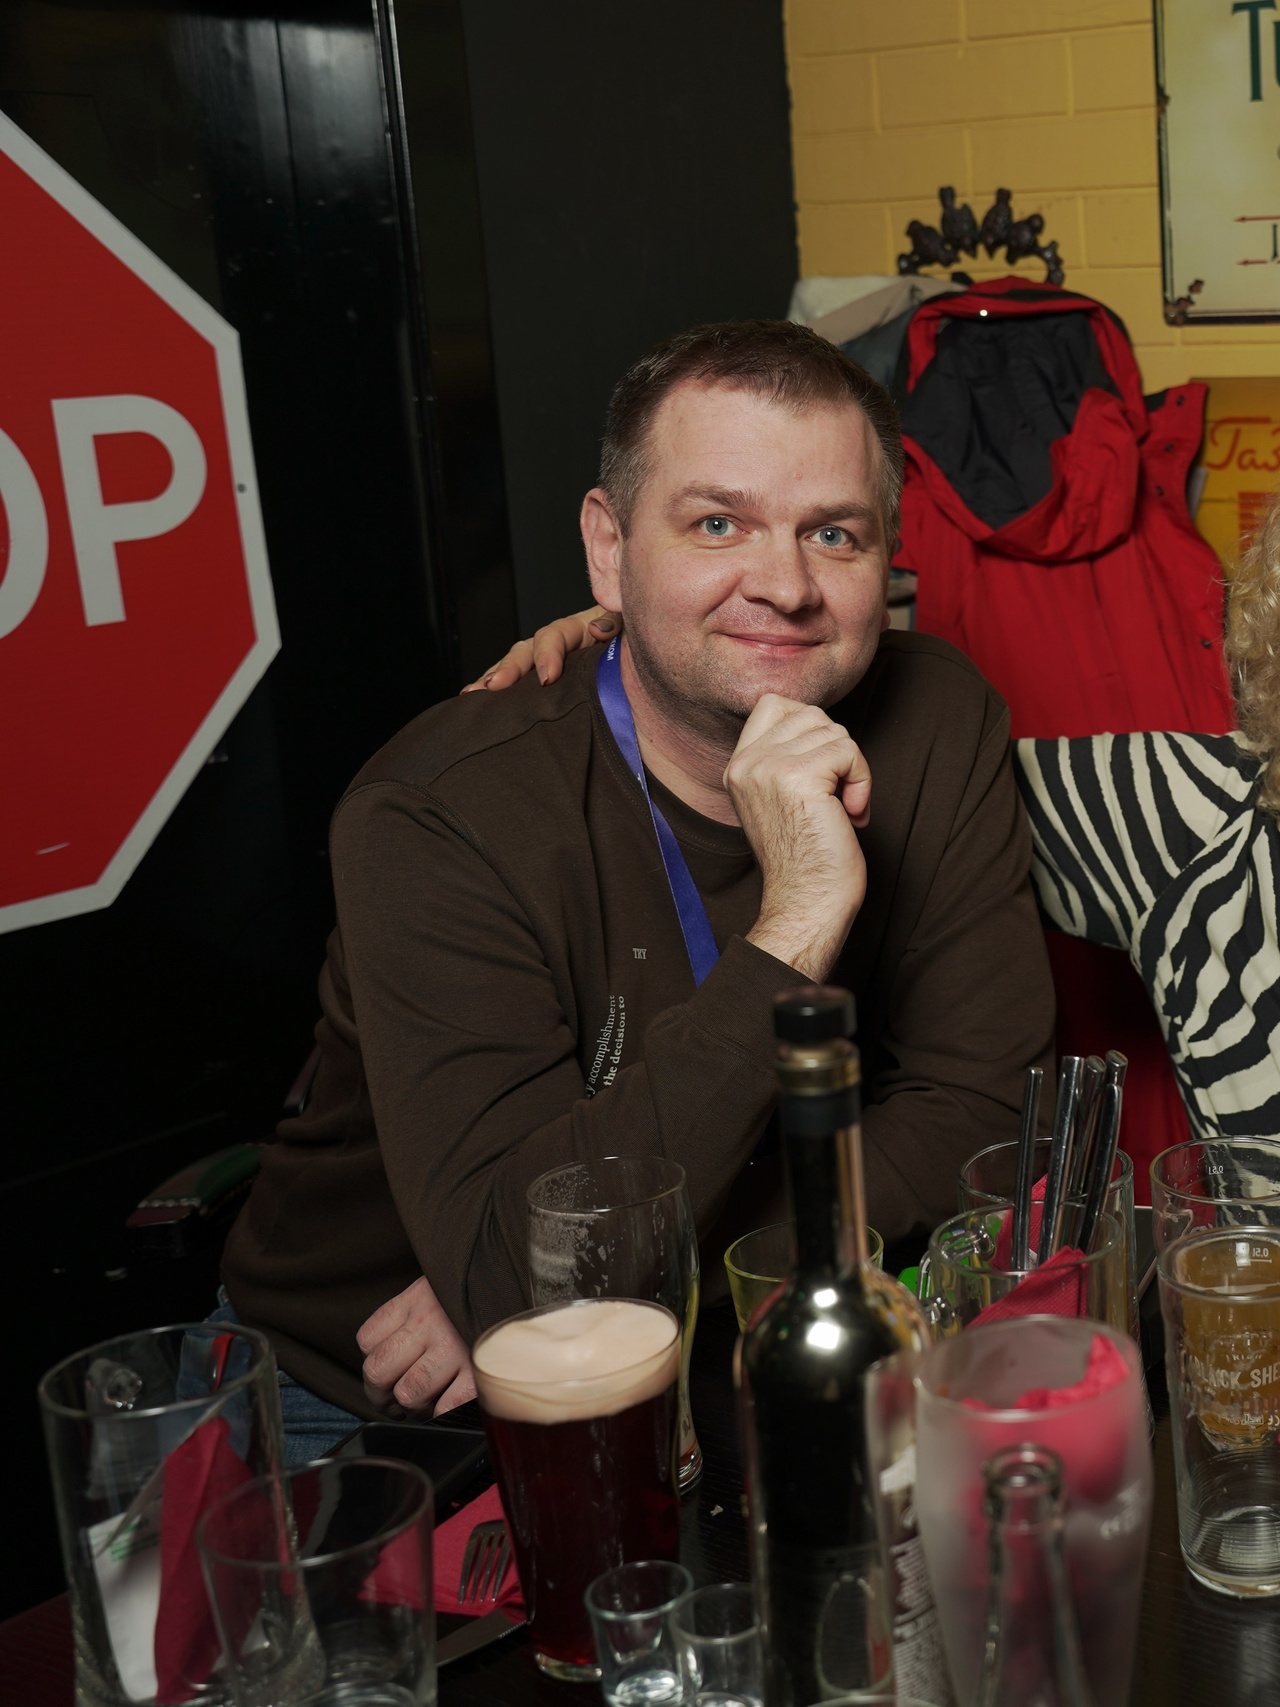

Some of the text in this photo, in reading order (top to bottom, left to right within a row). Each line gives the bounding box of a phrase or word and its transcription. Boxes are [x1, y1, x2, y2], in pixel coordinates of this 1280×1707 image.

[588, 994, 616, 1084] accomplishment
[603, 995, 626, 1086] the decision to
